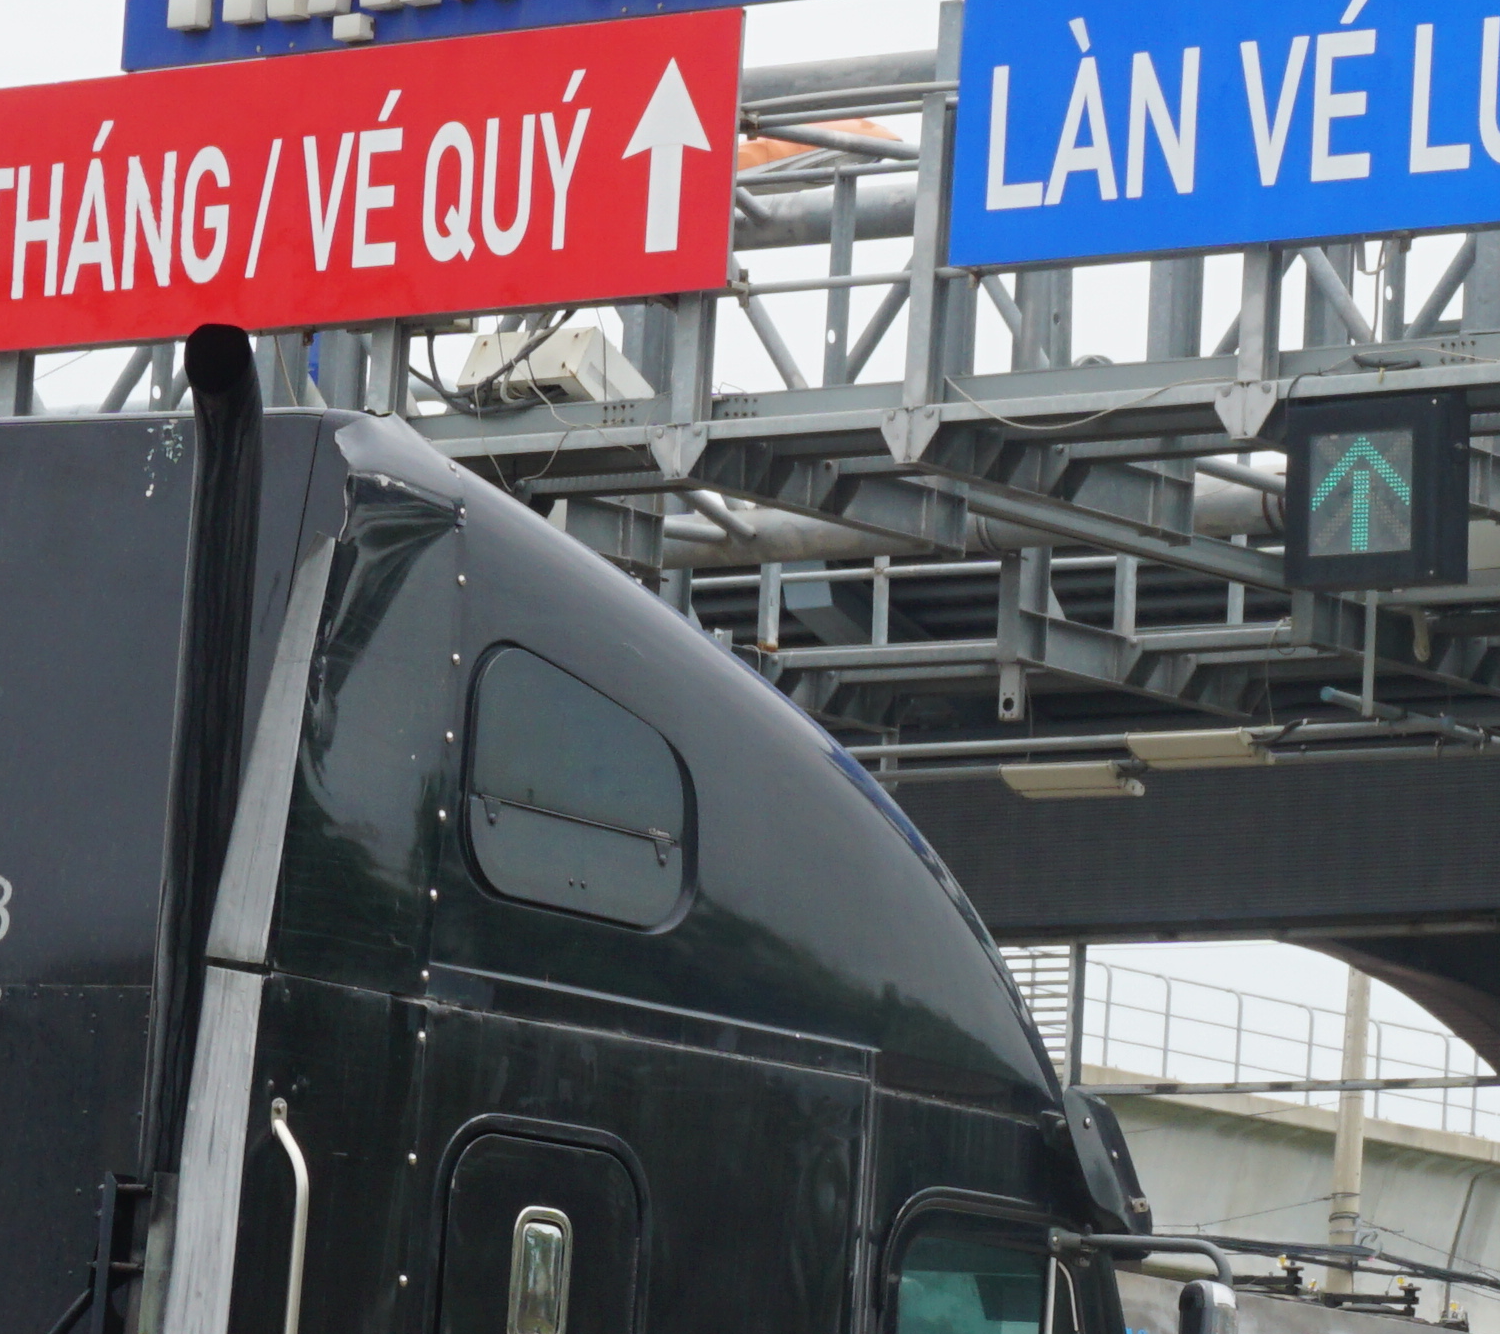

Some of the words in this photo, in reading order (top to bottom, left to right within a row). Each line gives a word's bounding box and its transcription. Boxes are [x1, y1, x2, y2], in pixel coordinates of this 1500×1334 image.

[303, 89, 403, 273] VÉ
[422, 70, 590, 262] QUÝ
[986, 18, 1200, 211] LÀN
